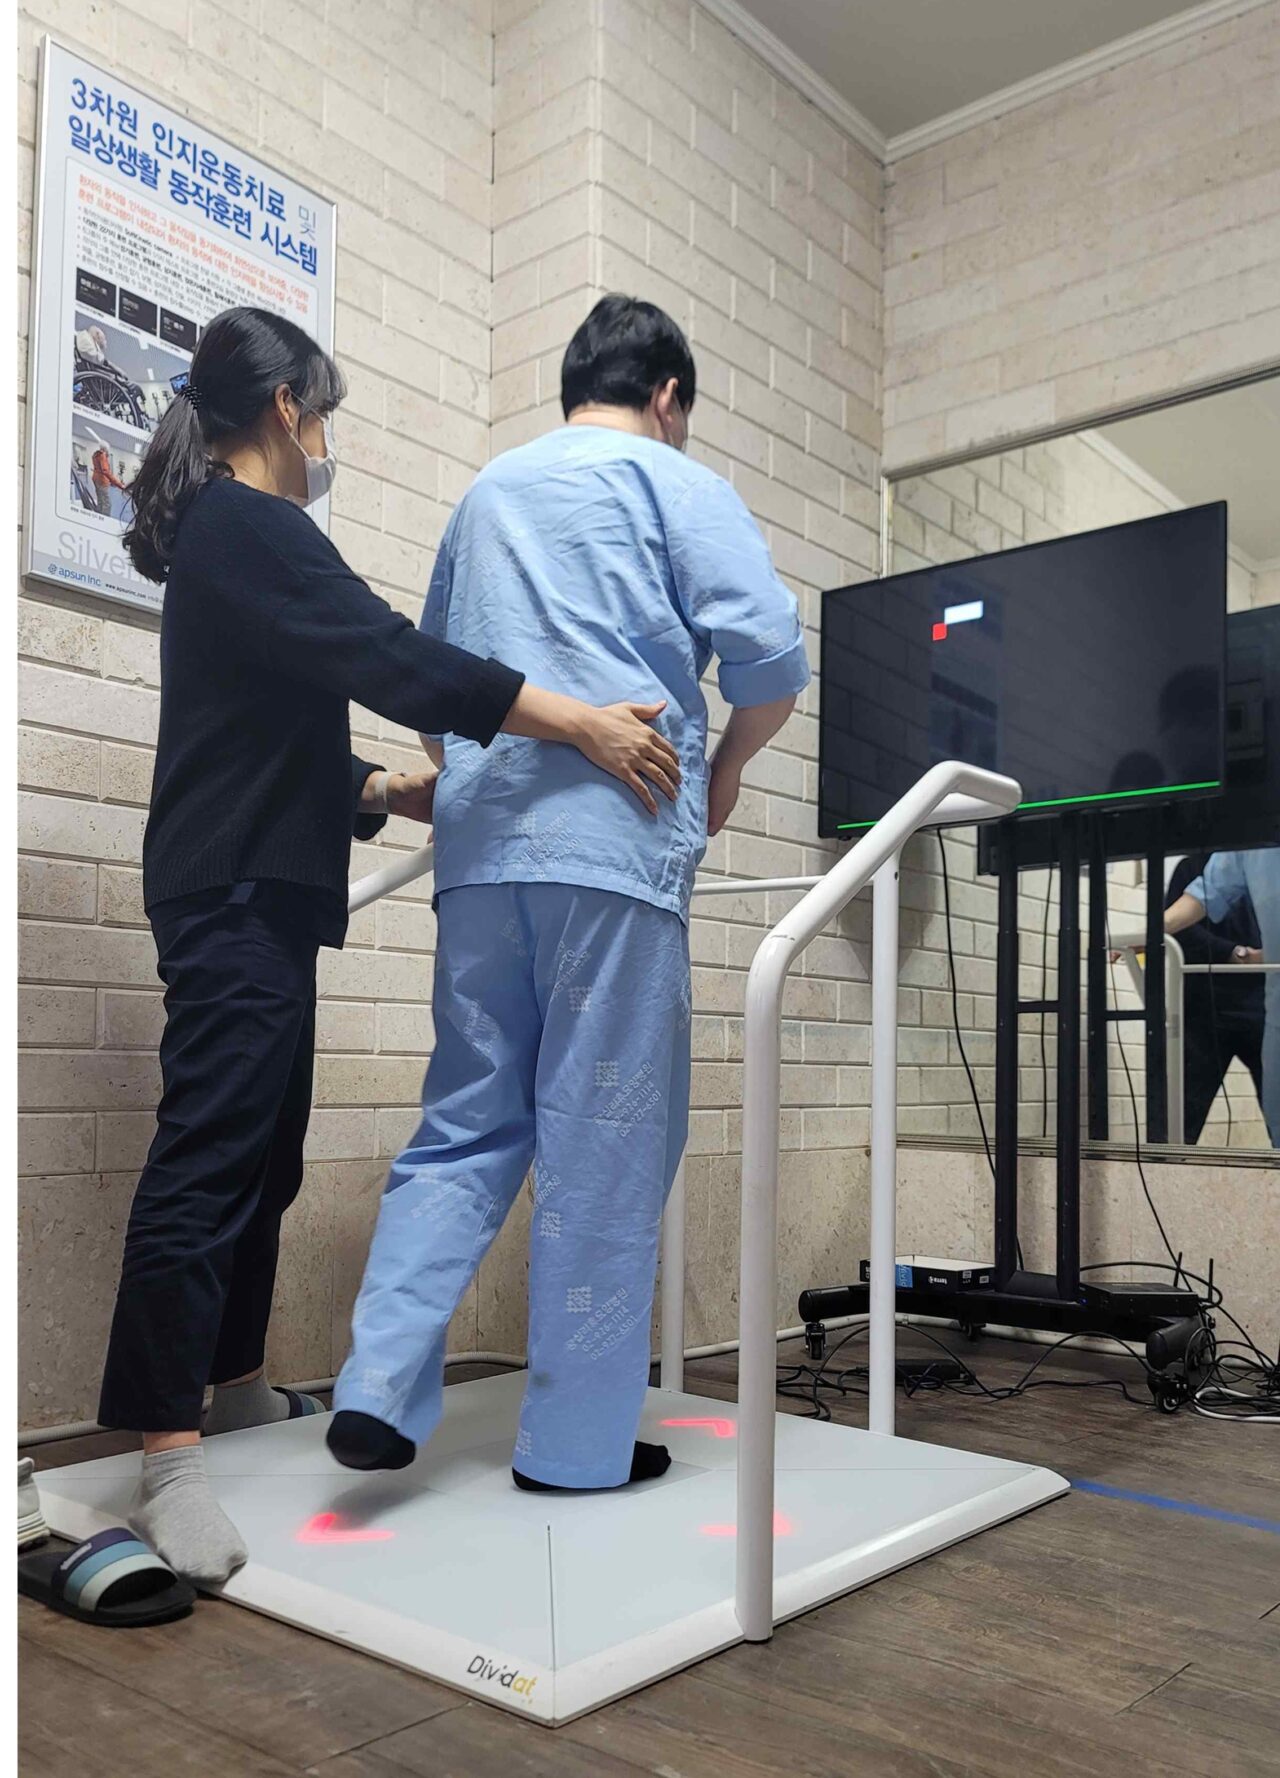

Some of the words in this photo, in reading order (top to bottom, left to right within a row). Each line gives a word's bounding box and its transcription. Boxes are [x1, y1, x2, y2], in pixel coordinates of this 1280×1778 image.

[69, 115, 160, 190] 일상생활
[168, 170, 251, 240] 동작훈련
[261, 222, 317, 276] 시스템
[71, 78, 138, 140] 3차원
[152, 122, 286, 222] 인지운동치료
[58, 531, 140, 581] Silver
[59, 567, 87, 582] apsun
